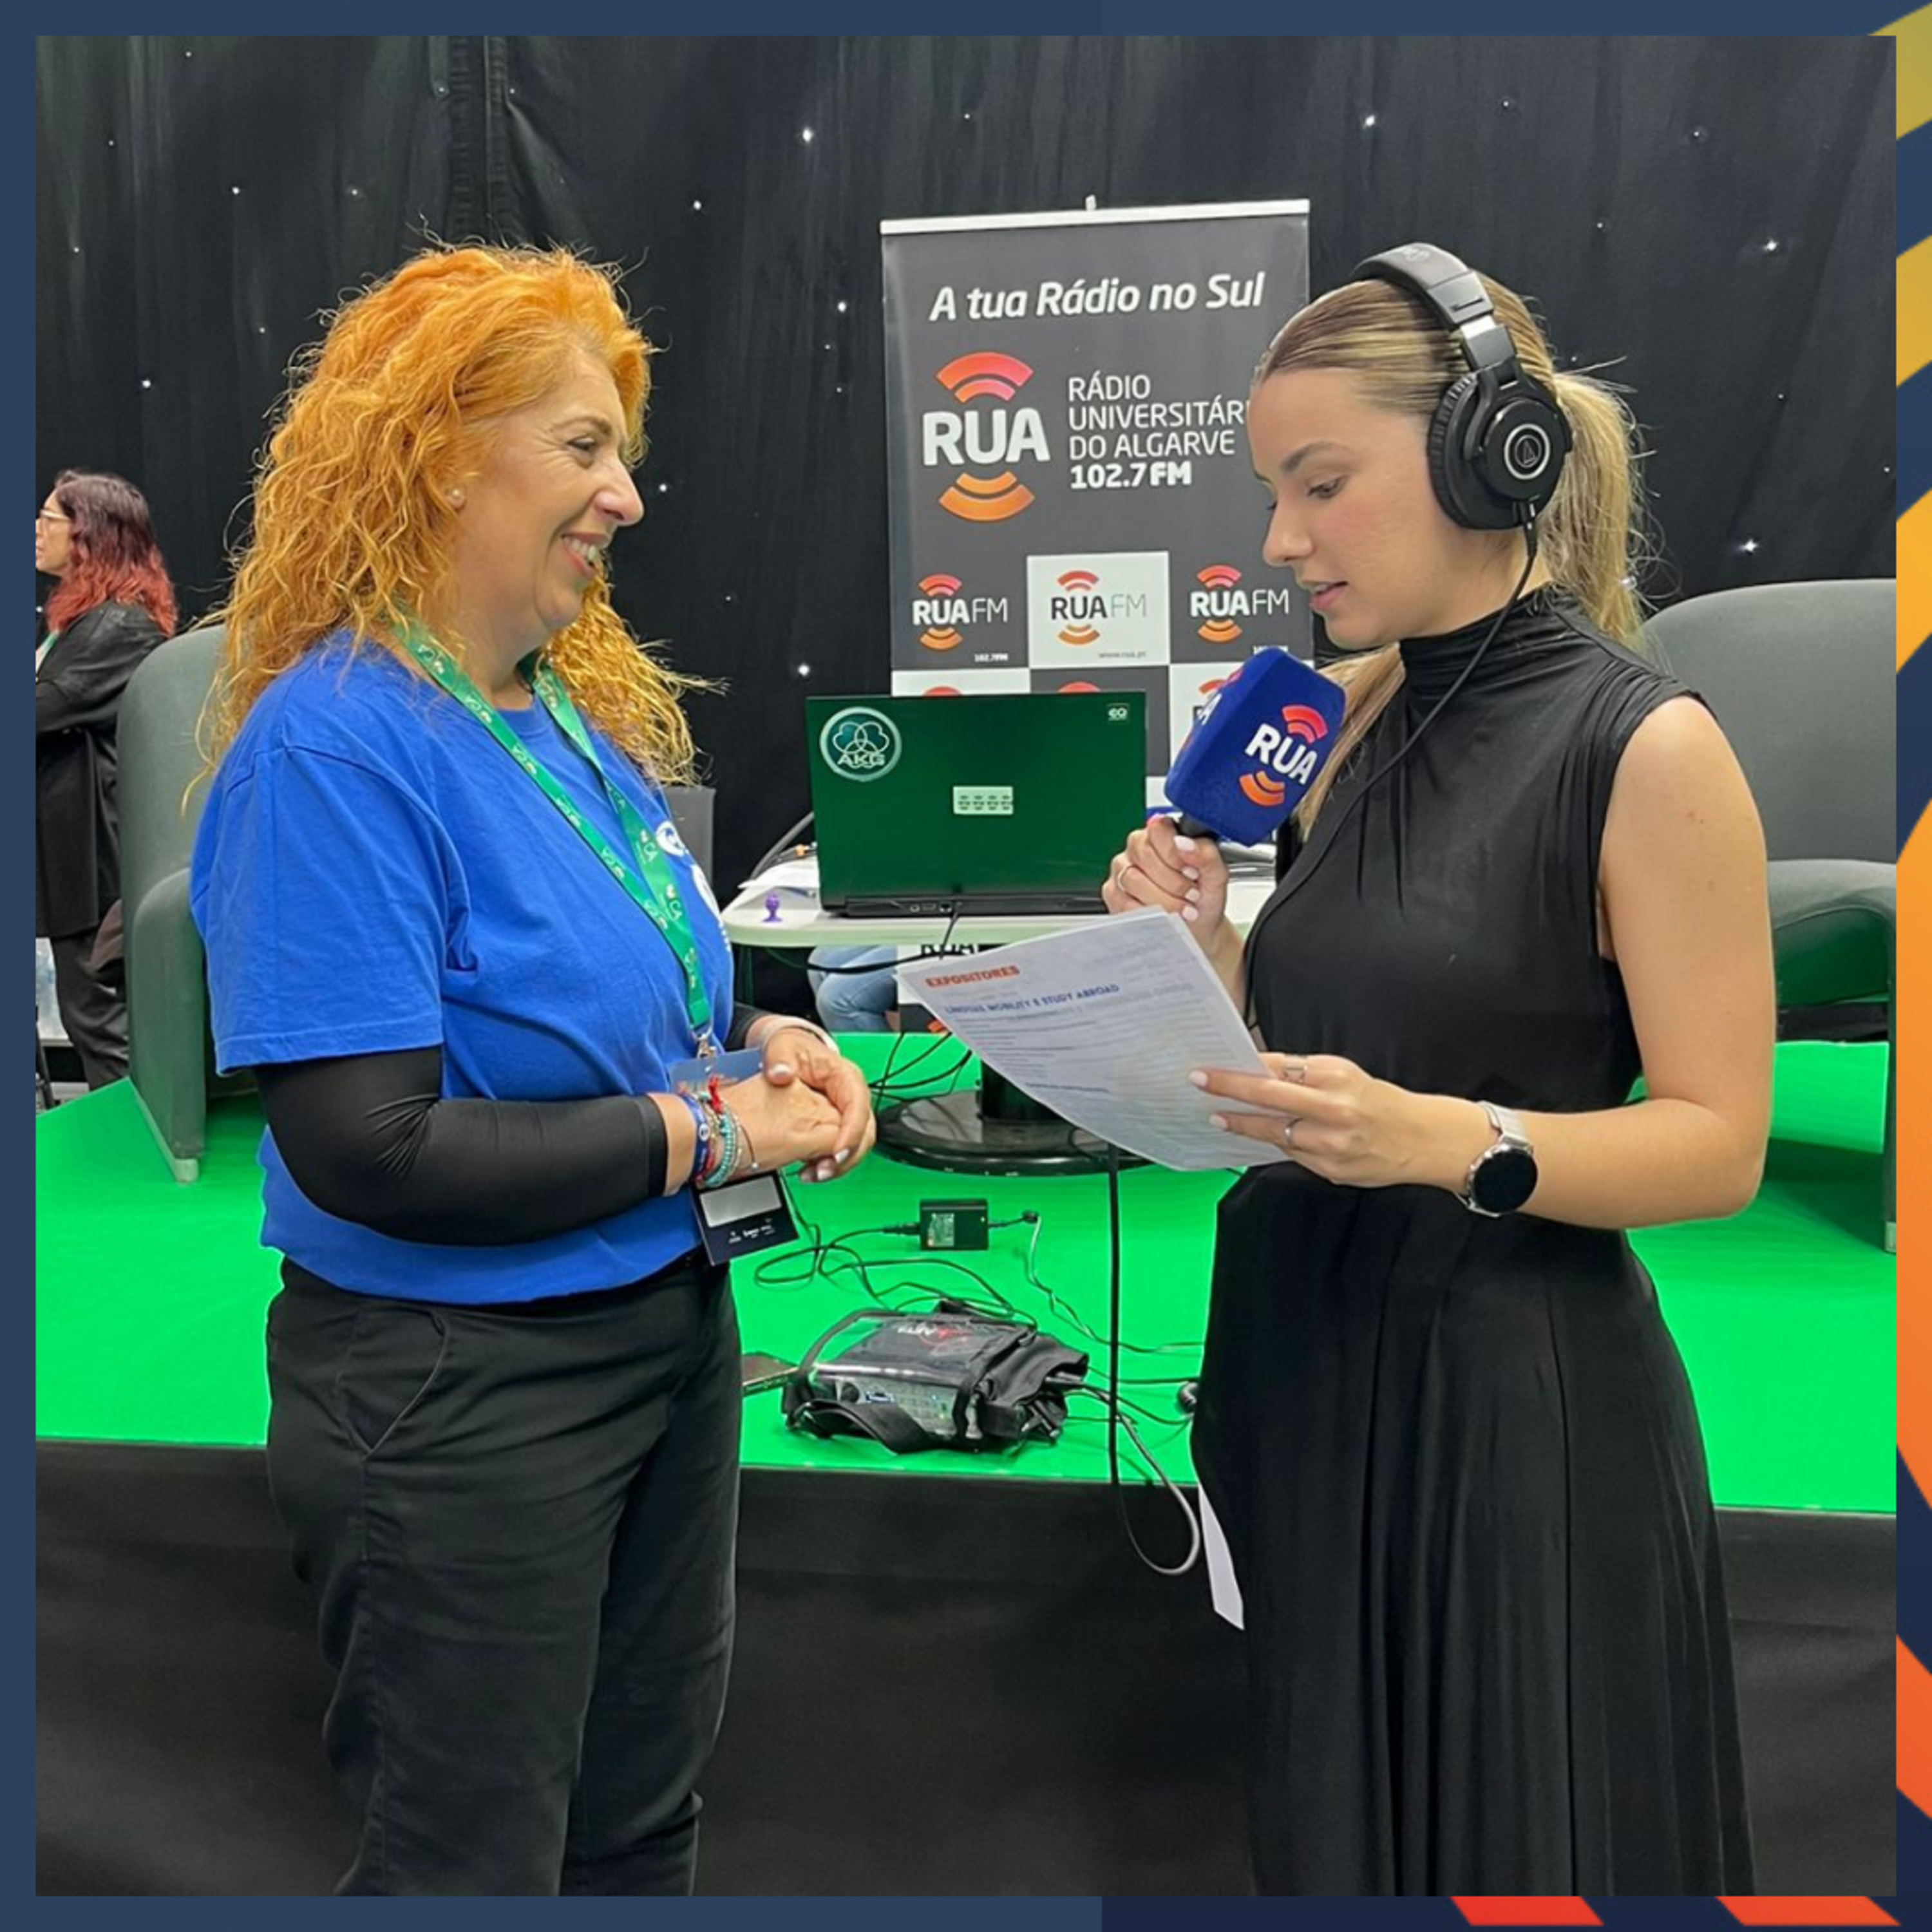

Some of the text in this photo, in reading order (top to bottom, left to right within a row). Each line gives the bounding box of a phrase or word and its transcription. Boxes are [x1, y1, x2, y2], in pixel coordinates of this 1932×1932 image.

[929, 272, 1265, 321] A tua Rádio no Sul
[1068, 372, 1151, 401] RÁDIO
[922, 407, 1050, 466] RUA
[1070, 430, 1235, 460] DO ALGARVE
[838, 753, 886, 766] AKG
[1244, 723, 1318, 785] RUA
[925, 965, 1020, 988] EXPOSITORES
[1041, 992, 1073, 1007] STUDY
[1076, 983, 1121, 999] ABROAD
